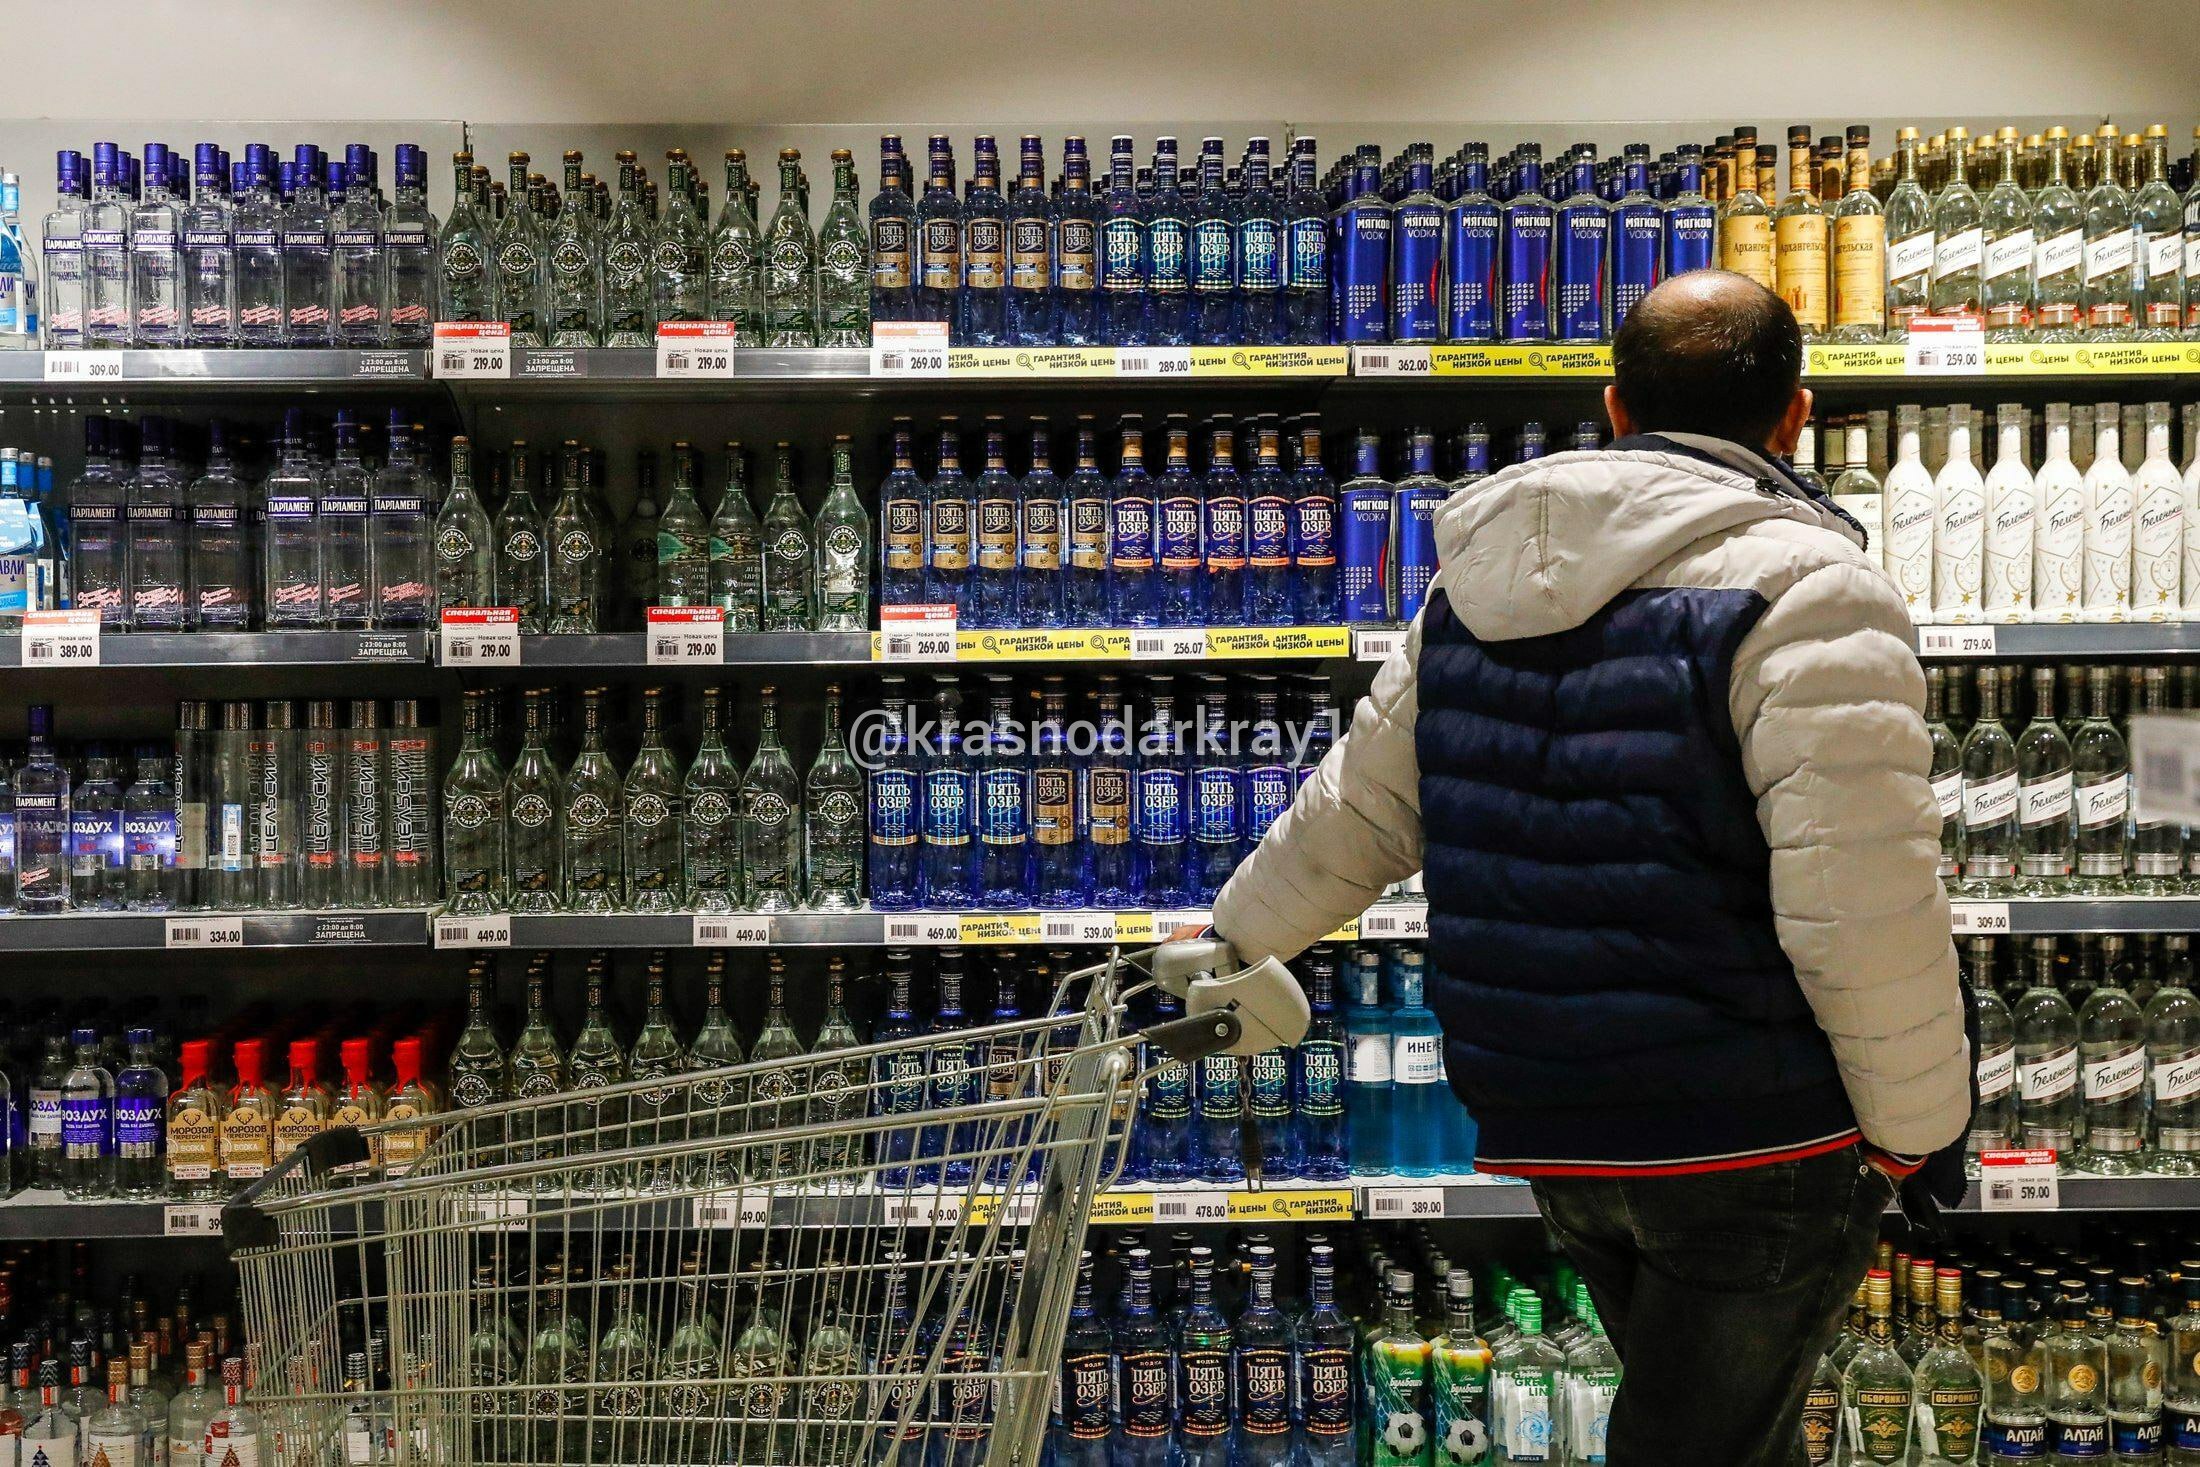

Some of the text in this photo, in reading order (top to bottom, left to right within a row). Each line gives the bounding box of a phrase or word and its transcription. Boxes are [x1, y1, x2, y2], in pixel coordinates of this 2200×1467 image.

[1356, 218, 1389, 229] МЯГКОВ
[1404, 217, 1440, 228] МЯГКОВ
[1462, 217, 1497, 228] МЯГКОВ
[1514, 217, 1551, 228] МЯГКОВ
[1574, 217, 1606, 228] МЯГКОВ
[1626, 217, 1660, 228] МЯГКОВ
[1675, 217, 1712, 229] МЯГКОВ
[879, 227, 904, 236] ПЯТЬ
[1361, 230, 1386, 240] VODKA
[1408, 228, 1437, 238] VODKA
[1466, 229, 1495, 238] VODKA
[1519, 229, 1547, 238] VODKA
[1579, 229, 1603, 238] VODKA
[1630, 229, 1657, 238] VODKA
[1679, 230, 1709, 240] VODKA
[83, 234, 124, 243] ПАРЛАМЕНТ
[134, 234, 175, 244] ПАРЛАМЕНТ
[186, 234, 226, 244] ПАРЛАМЕНТ
[235, 234, 276, 244] ПАРЛАМЕНТ
[285, 235, 325, 244] ПАРЛАМЕНТ
[335, 234, 375, 244] ПАРЛАМЕНТ
[385, 234, 425, 243] ПАРЛАМЕНТ
[879, 236, 904, 245] ОЗЕР
[1034, 354, 1081, 362] ГАРАНТИЯ
[1437, 353, 1484, 361] ГАРАНТИЯ
[1546, 353, 1594, 362] ГАРАНТИЯ
[1828, 352, 1876, 361] ГАРАНТИЯ
[1996, 355, 2023, 364] ЦЕНЫ
[2093, 349, 2142, 359] ГАРАНТИЯ
[2110, 354, 2180, 365] НИЗКОЙ ЦЕНЫ
[983, 358, 1010, 366] ЦЕНЫ
[1199, 358, 1226, 366] ЦЕНЫ
[1317, 357, 1345, 366] ЦЕНЫ
[1398, 360, 1427, 370] 362.00
[1453, 358, 1522, 368] НИЗКОЙ ЦЕНЫ
[1562, 358, 1600, 368] НИЗКОЙ
[1844, 356, 1904, 367] НИЗКОЙ ЦЕН
[360, 366, 409, 374] ЗАПРЕЩЕНА
[526, 365, 575, 373] ЗАПРЕЩЕНА
[268, 501, 314, 513] ПАРЛАМЕНТ
[322, 500, 367, 512] ПАРЛАМЕНТ
[375, 500, 420, 511] ПАРЛАМЕНТ
[1353, 500, 1389, 510] МЯГКОВ
[71, 508, 116, 519] ПАРЛАМЕНТ
[128, 508, 173, 518] ПАРЛАМЕНТ
[193, 508, 238, 519] ПАРЛАМЕНТ
[1357, 512, 1385, 521] VODKA
[1000, 637, 1047, 646] ГАРАНТИЯ
[1216, 634, 1263, 643] ГАРАНТИЯ
[1316, 639, 1344, 648] ЦЕНЫ
[1962, 638, 1992, 650] 279.00
[1016, 641, 1084, 652] НИЗКОЙ ЦЕНЫ
[1232, 640, 1270, 650] НИЗКОЙ
[358, 648, 408, 656] ЗАПРЕЩЕНА
[1039, 777, 1065, 787] ПЯТЬ
[1096, 777, 1123, 787] ПЯТЬ
[877, 784, 911, 796] ПЯТЬ
[931, 784, 964, 796] ПЯТЬ
[987, 784, 1020, 795] ПЯТЬ
[1039, 787, 1065, 796] ОЗЕР
[1096, 787, 1123, 796] ОЗЕР
[1145, 783, 1178, 794] ПЯТЬ
[1200, 782, 1234, 794] ПЯТЬ
[1253, 782, 1286, 794] ПЯТЬ
[15, 797, 56, 808] ПАРЛАМЕНТ
[878, 797, 911, 808] ОЗЕР
[931, 797, 964, 808] ОЗЕР
[987, 796, 1020, 808] ОЗЕР
[1145, 796, 1178, 807] ОЗЕР
[1200, 795, 1234, 807] ОЗЕР
[1253, 794, 1286, 806] ОЗЕР
[125, 821, 170, 834] ВОЗДУХ
[961, 922, 1009, 932] ГАРАНТИЯ
[1977, 916, 2006, 928] 309.00
[210, 931, 240, 943] 334.00
[315, 931, 366, 939] ЗАПРЕЩЕНА
[478, 930, 508, 942] 449.00
[736, 929, 766, 942] 449.00
[927, 928, 957, 939] 469.00
[1084, 927, 1113, 939] 539.00
[1305, 1054, 1339, 1067] ПЯТЬ
[1306, 1067, 1339, 1079] ОЗЕР
[62, 1108, 107, 1121] ВОЗДУХ
[116, 1108, 162, 1121] ВОЗДУХ
[224, 1125, 266, 1133] МОРОЗОВ
[277, 1125, 320, 1133] МОРОЗОВ
[1290, 1199, 1337, 1208] ГАРАНТИЯ
[1412, 1202, 1441, 1213] 389.00
[1195, 1206, 1225, 1217] 478.00
[1239, 1205, 1266, 1214] ЦЕНЫ
[1306, 1205, 1343, 1214] НИЗКОЙ
[1077, 1370, 1108, 1384] ПЯТЬ
[1132, 1368, 1167, 1382] ПЯТЬ
[1189, 1366, 1224, 1381] ПЯТЬ
[1249, 1366, 1284, 1380] ПЯТЬ
[1314, 1365, 1348, 1380] ПЯТЬ
[1077, 1384, 1108, 1397] ОЗЕР
[1132, 1382, 1167, 1396] ОЗЕР
[1189, 1381, 1224, 1394] ОЗЕР
[1249, 1380, 1284, 1393] ОЗЕР
[1314, 1380, 1348, 1394] ОЗЕР
[1861, 1395, 1906, 1403] ОБОРОНКА
[2006, 1426, 2044, 1442] АЛТАЙ
[2064, 1426, 2103, 1442] АЛТАЙ
